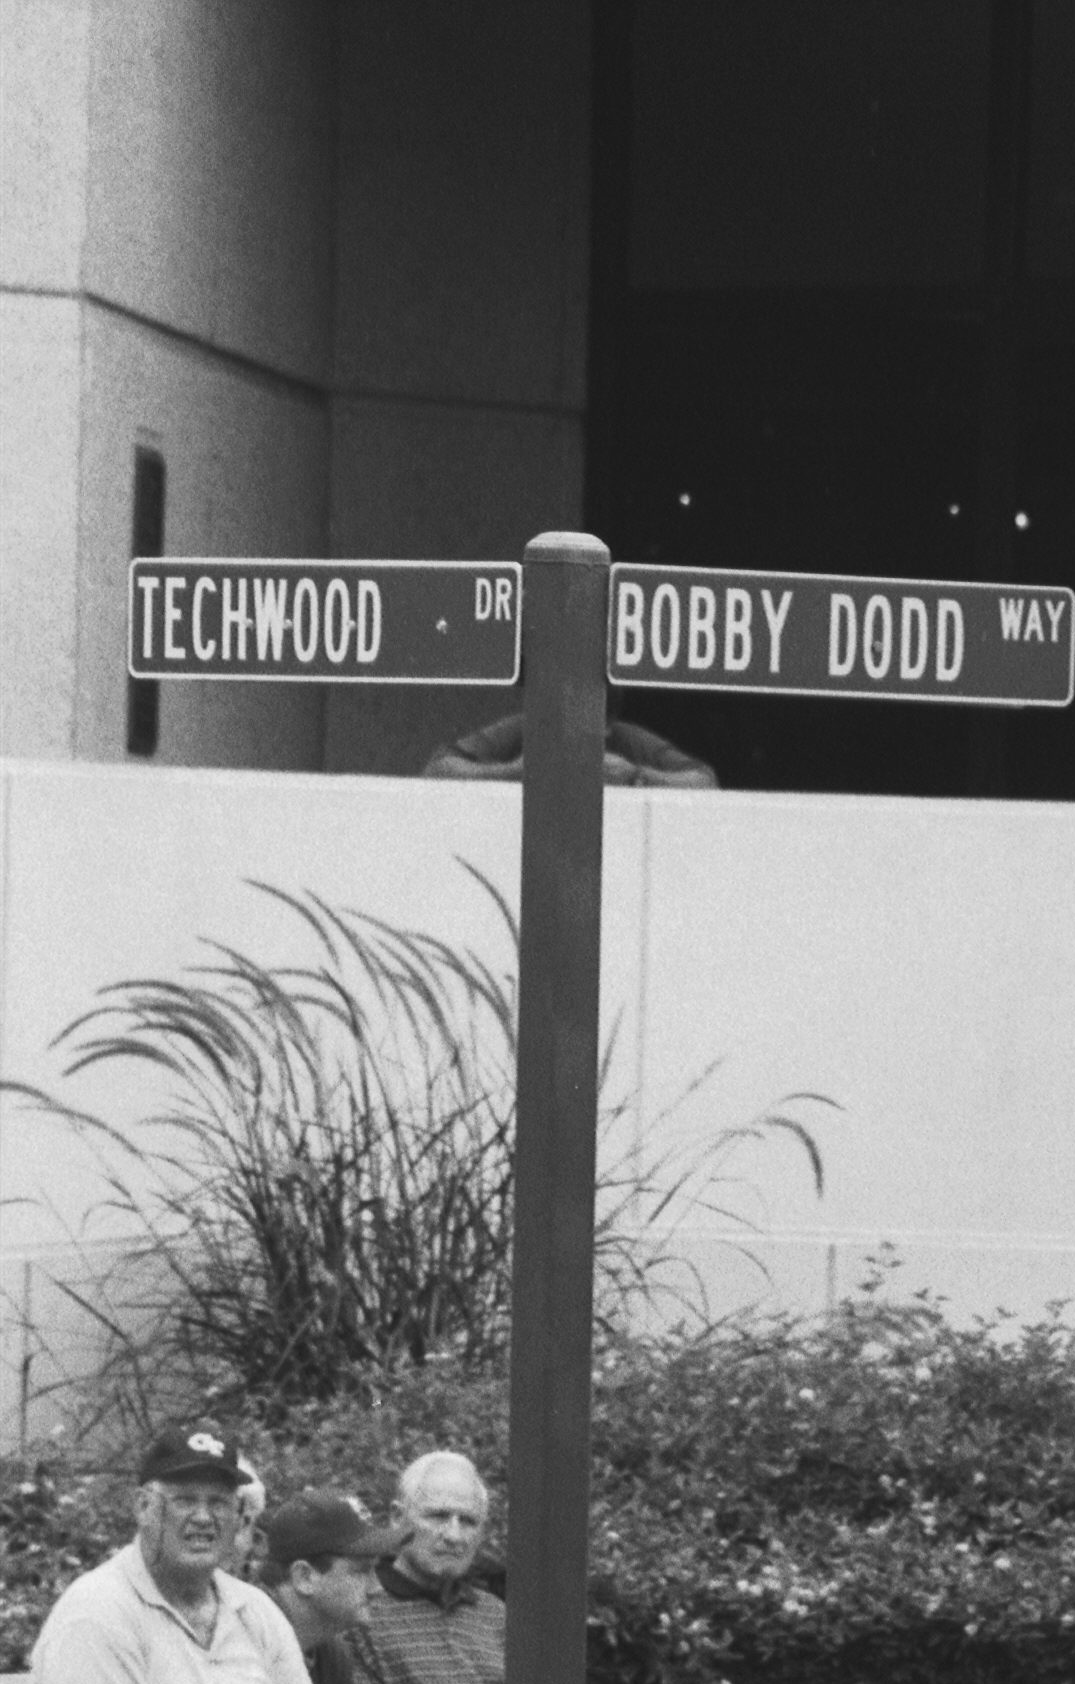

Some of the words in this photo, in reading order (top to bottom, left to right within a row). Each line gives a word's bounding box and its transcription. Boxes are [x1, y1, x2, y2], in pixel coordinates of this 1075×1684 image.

[138, 577, 382, 663] TECHWOOD
[475, 578, 512, 621] DR
[616, 581, 794, 674] BOBBY
[828, 593, 965, 682] DODD
[999, 597, 1067, 643] WAY
